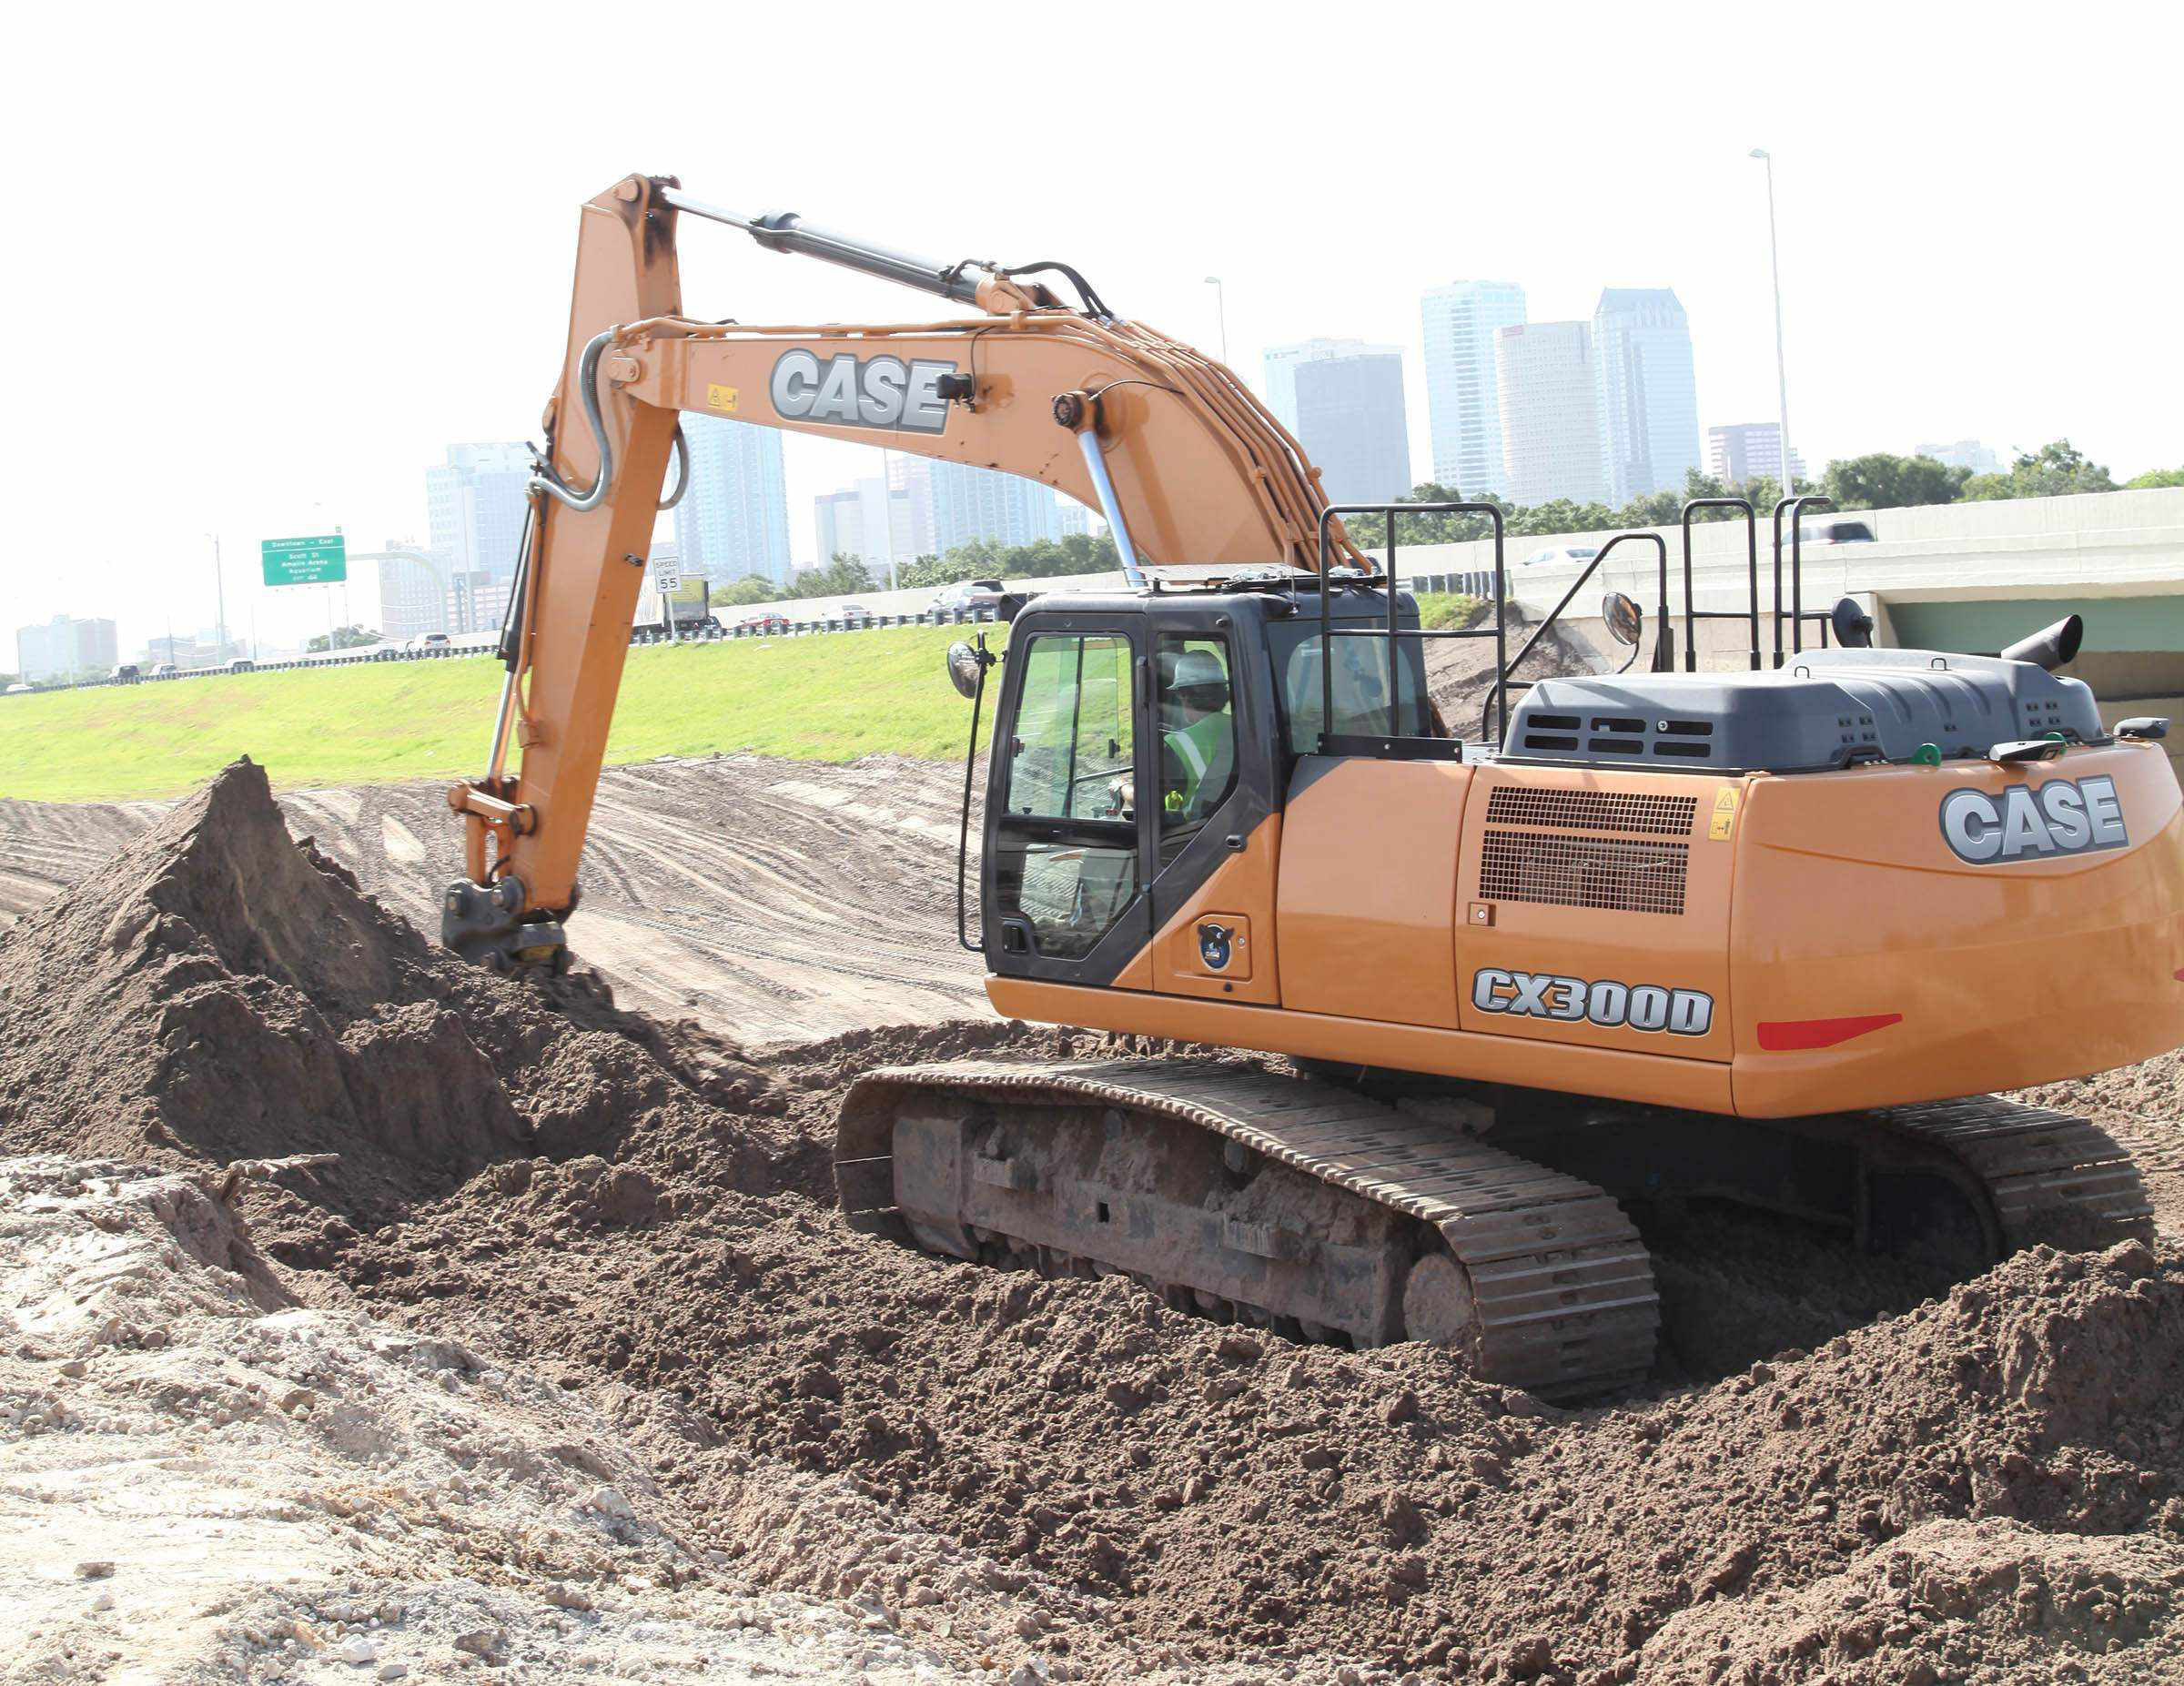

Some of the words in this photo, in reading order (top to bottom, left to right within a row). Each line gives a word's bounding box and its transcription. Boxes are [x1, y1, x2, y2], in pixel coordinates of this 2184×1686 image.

[771, 349, 956, 433] CASE
[660, 578, 677, 589] 55
[1941, 776, 2128, 863] CASE
[1473, 968, 1713, 1035] CX300D
